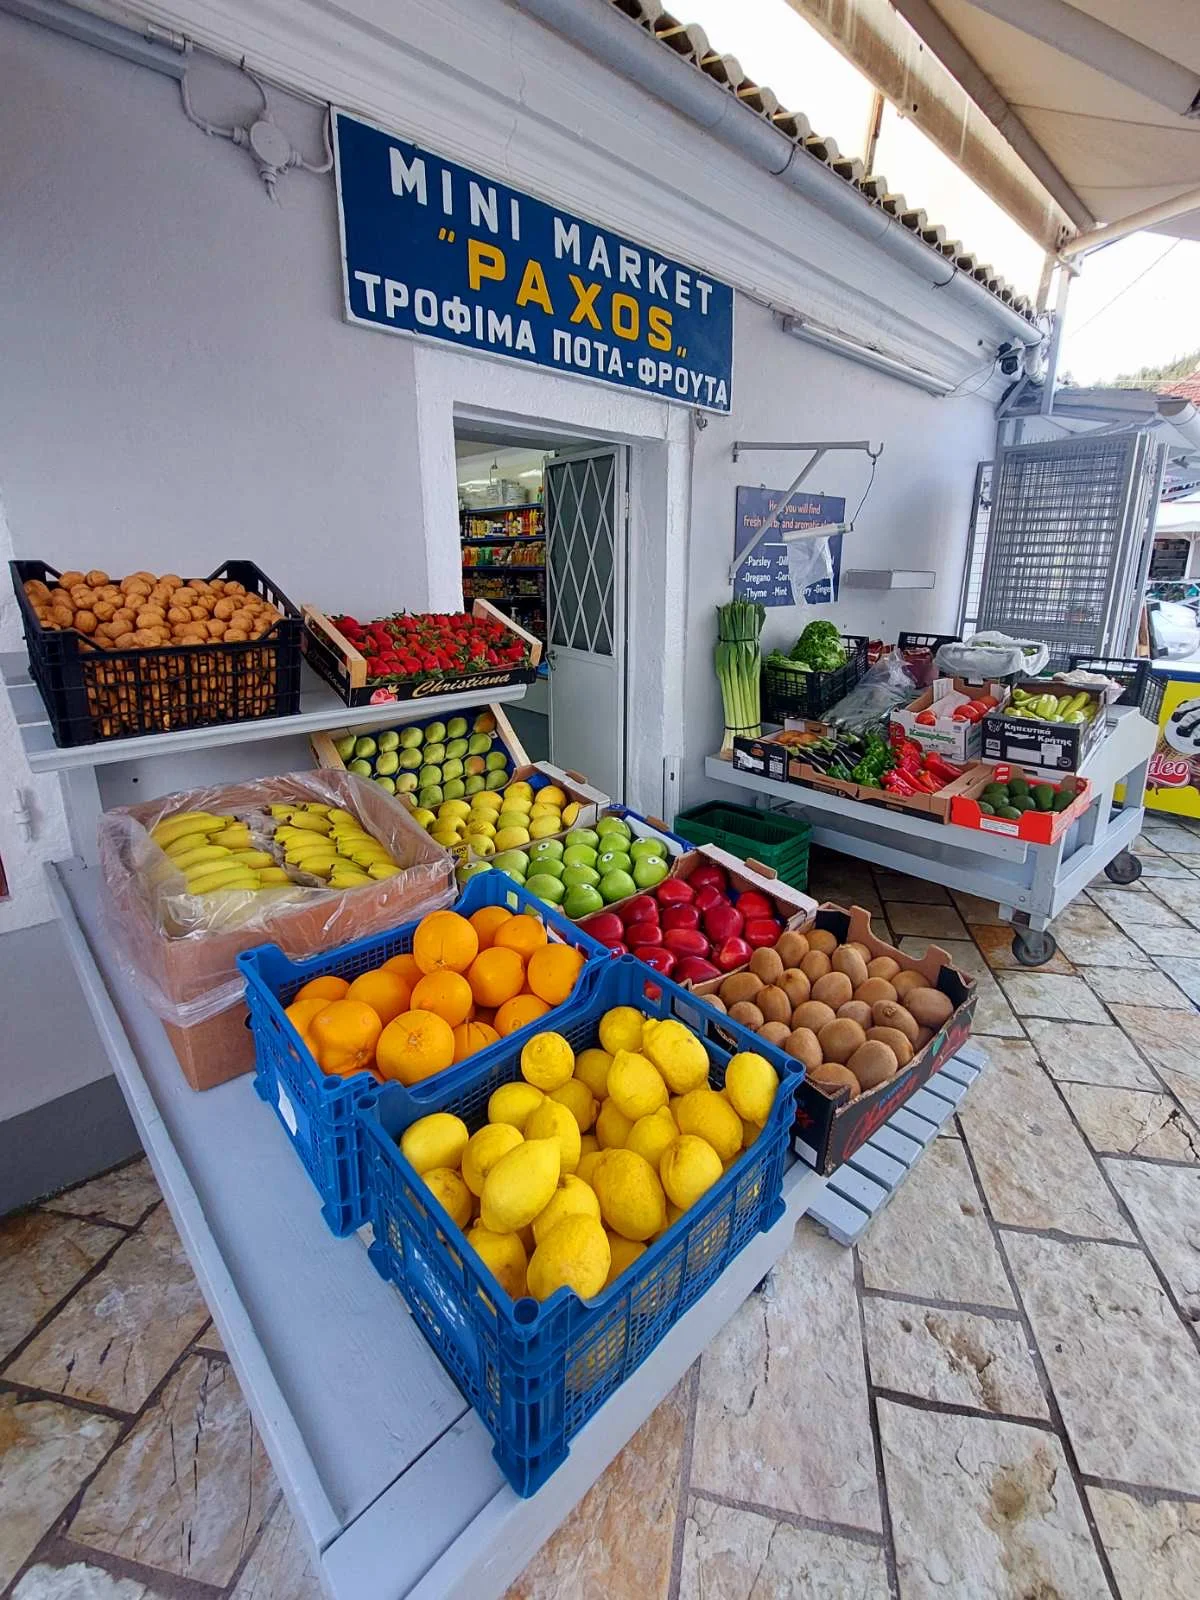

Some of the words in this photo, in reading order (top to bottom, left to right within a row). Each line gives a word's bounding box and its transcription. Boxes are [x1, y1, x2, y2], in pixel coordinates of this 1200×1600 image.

[389, 147, 520, 241] MINI
[553, 216, 713, 315] MARKET
[354, 271, 536, 354] ΤΡΟΦΙΜΑ
[553, 329, 728, 406] ΠΟΤΑ-ΦΡΟΥΤΑ
[785, 504, 797, 515] you
[797, 503, 809, 515] will
[808, 503, 821, 515] find
[782, 518, 794, 529] and
[411, 672, 511, 698] Christiana
[1037, 735, 1072, 747] Κρήτης
[1147, 754, 1189, 776] deo
